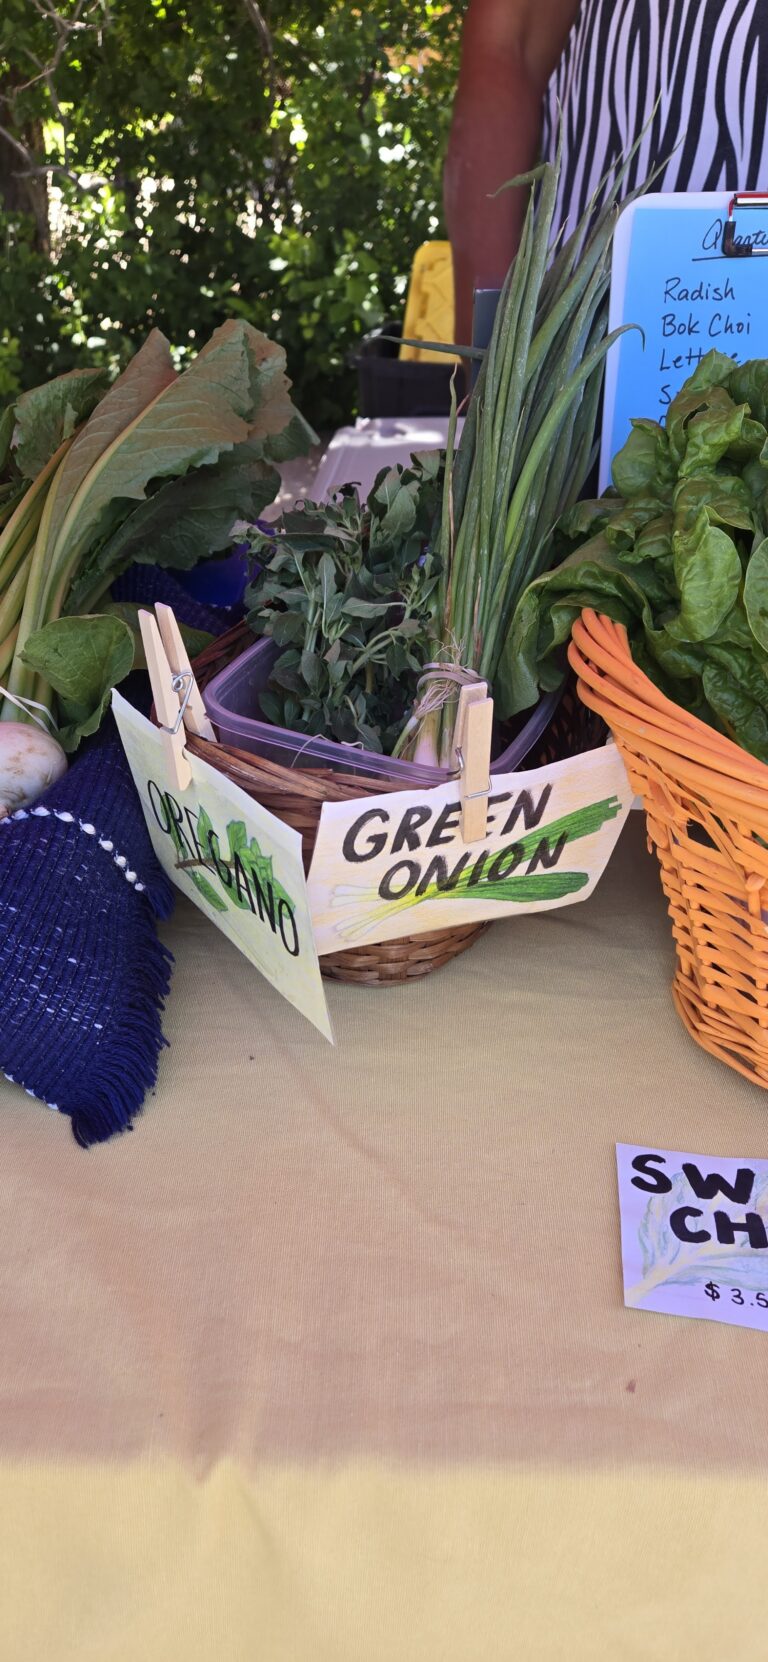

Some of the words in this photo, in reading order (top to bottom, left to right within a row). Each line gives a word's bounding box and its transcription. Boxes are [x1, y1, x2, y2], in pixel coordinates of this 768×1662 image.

[664, 276, 736, 304] Radish
[661, 312, 700, 338] Bok
[708, 312, 751, 338] Choi
[147, 779, 300, 957] OREGANO
[378, 831, 569, 900] ONION
